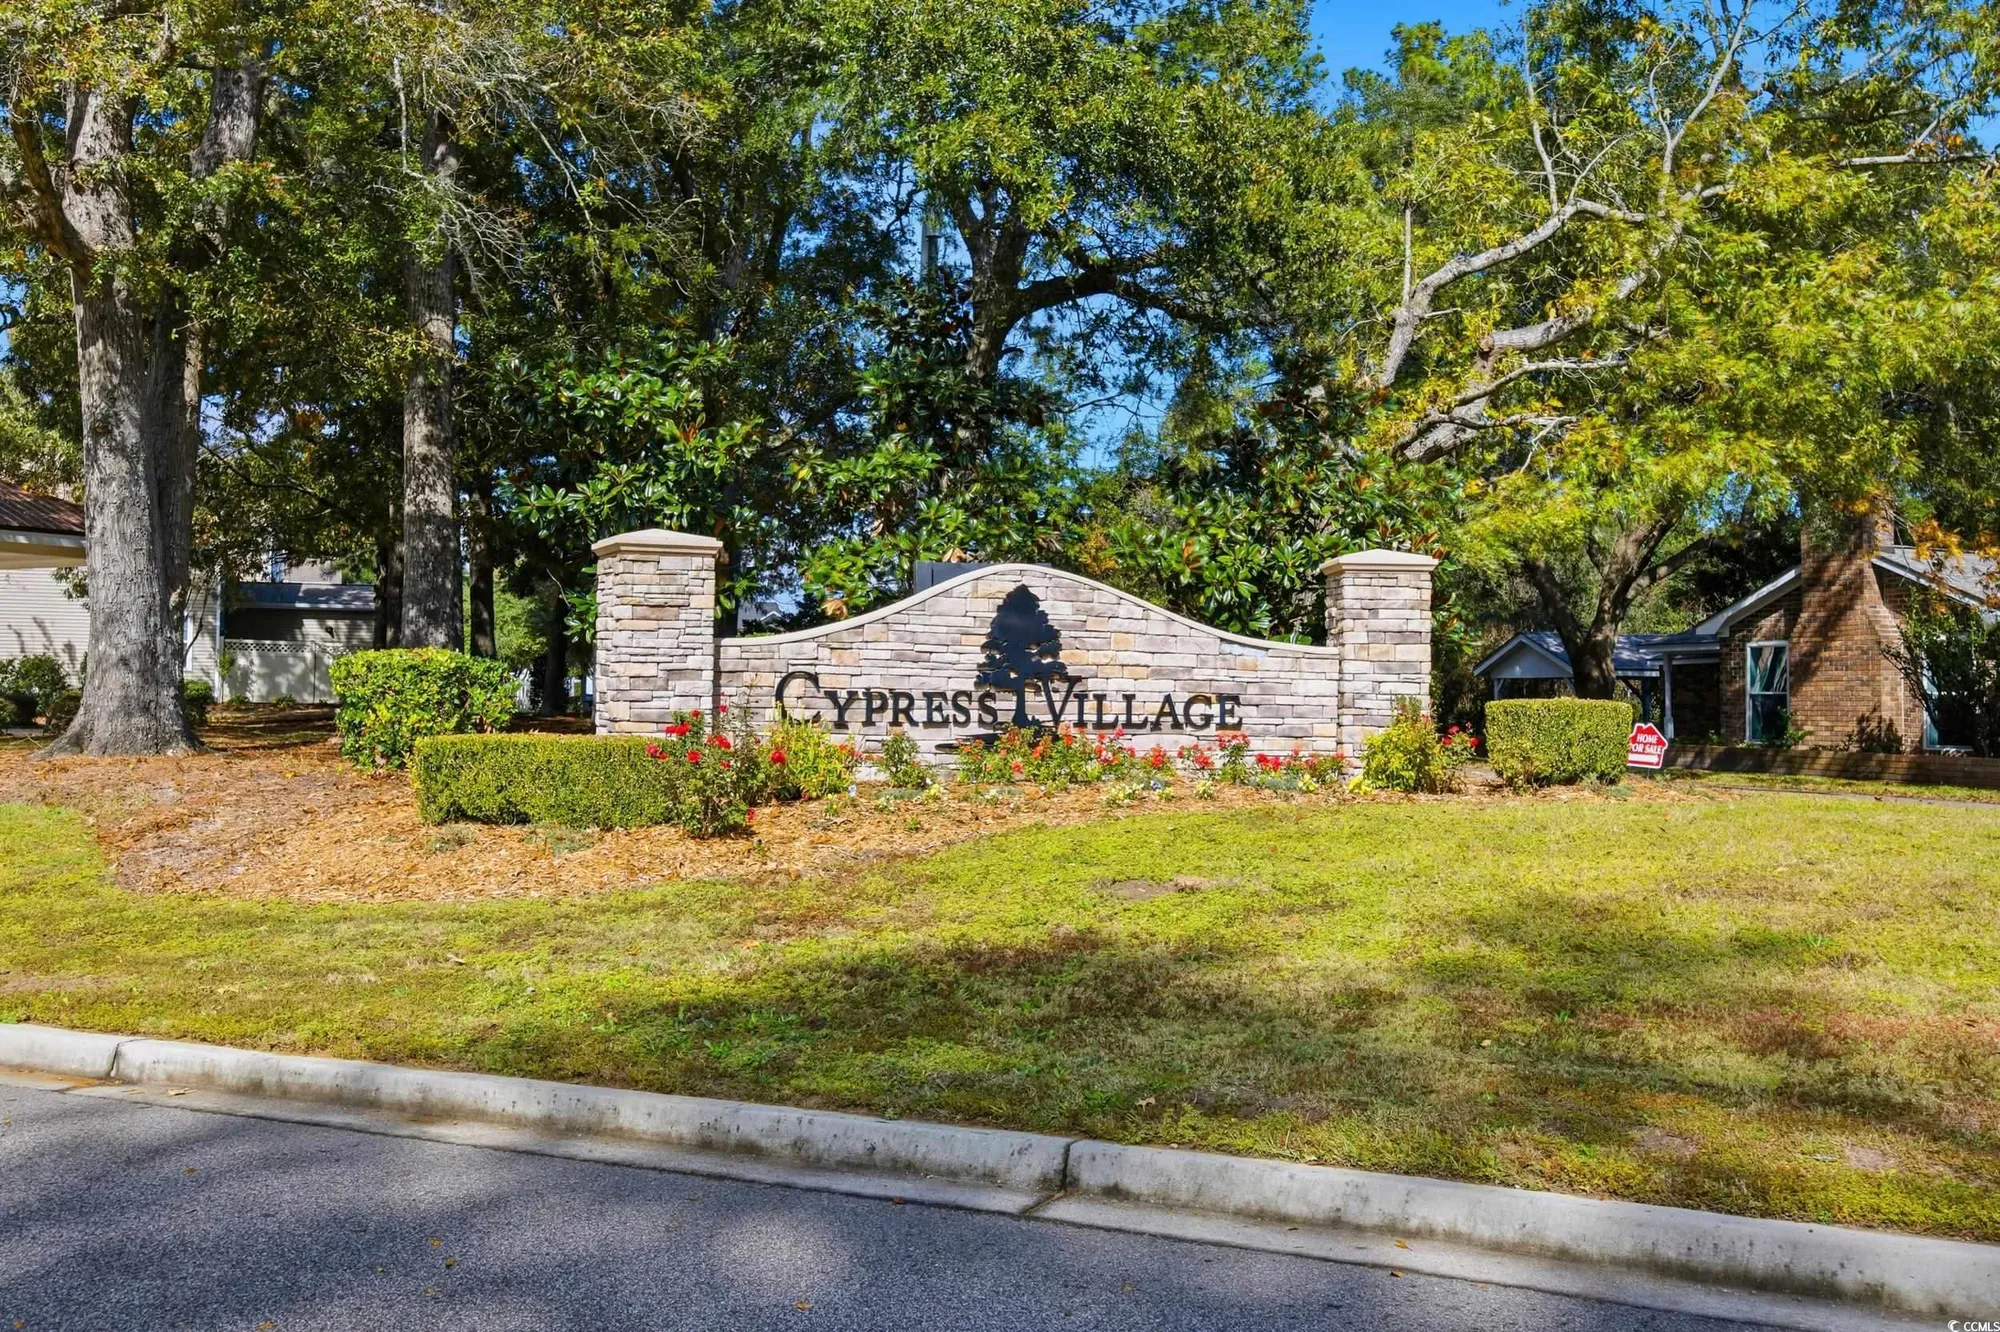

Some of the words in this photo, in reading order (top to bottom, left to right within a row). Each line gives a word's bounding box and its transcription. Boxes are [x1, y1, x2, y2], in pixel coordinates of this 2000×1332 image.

[776, 670, 998, 729] CYPRESS
[1034, 674, 1243, 731] VILLAGE
[1637, 733, 1658, 743] HOME
[1644, 744, 1661, 754] SALE
